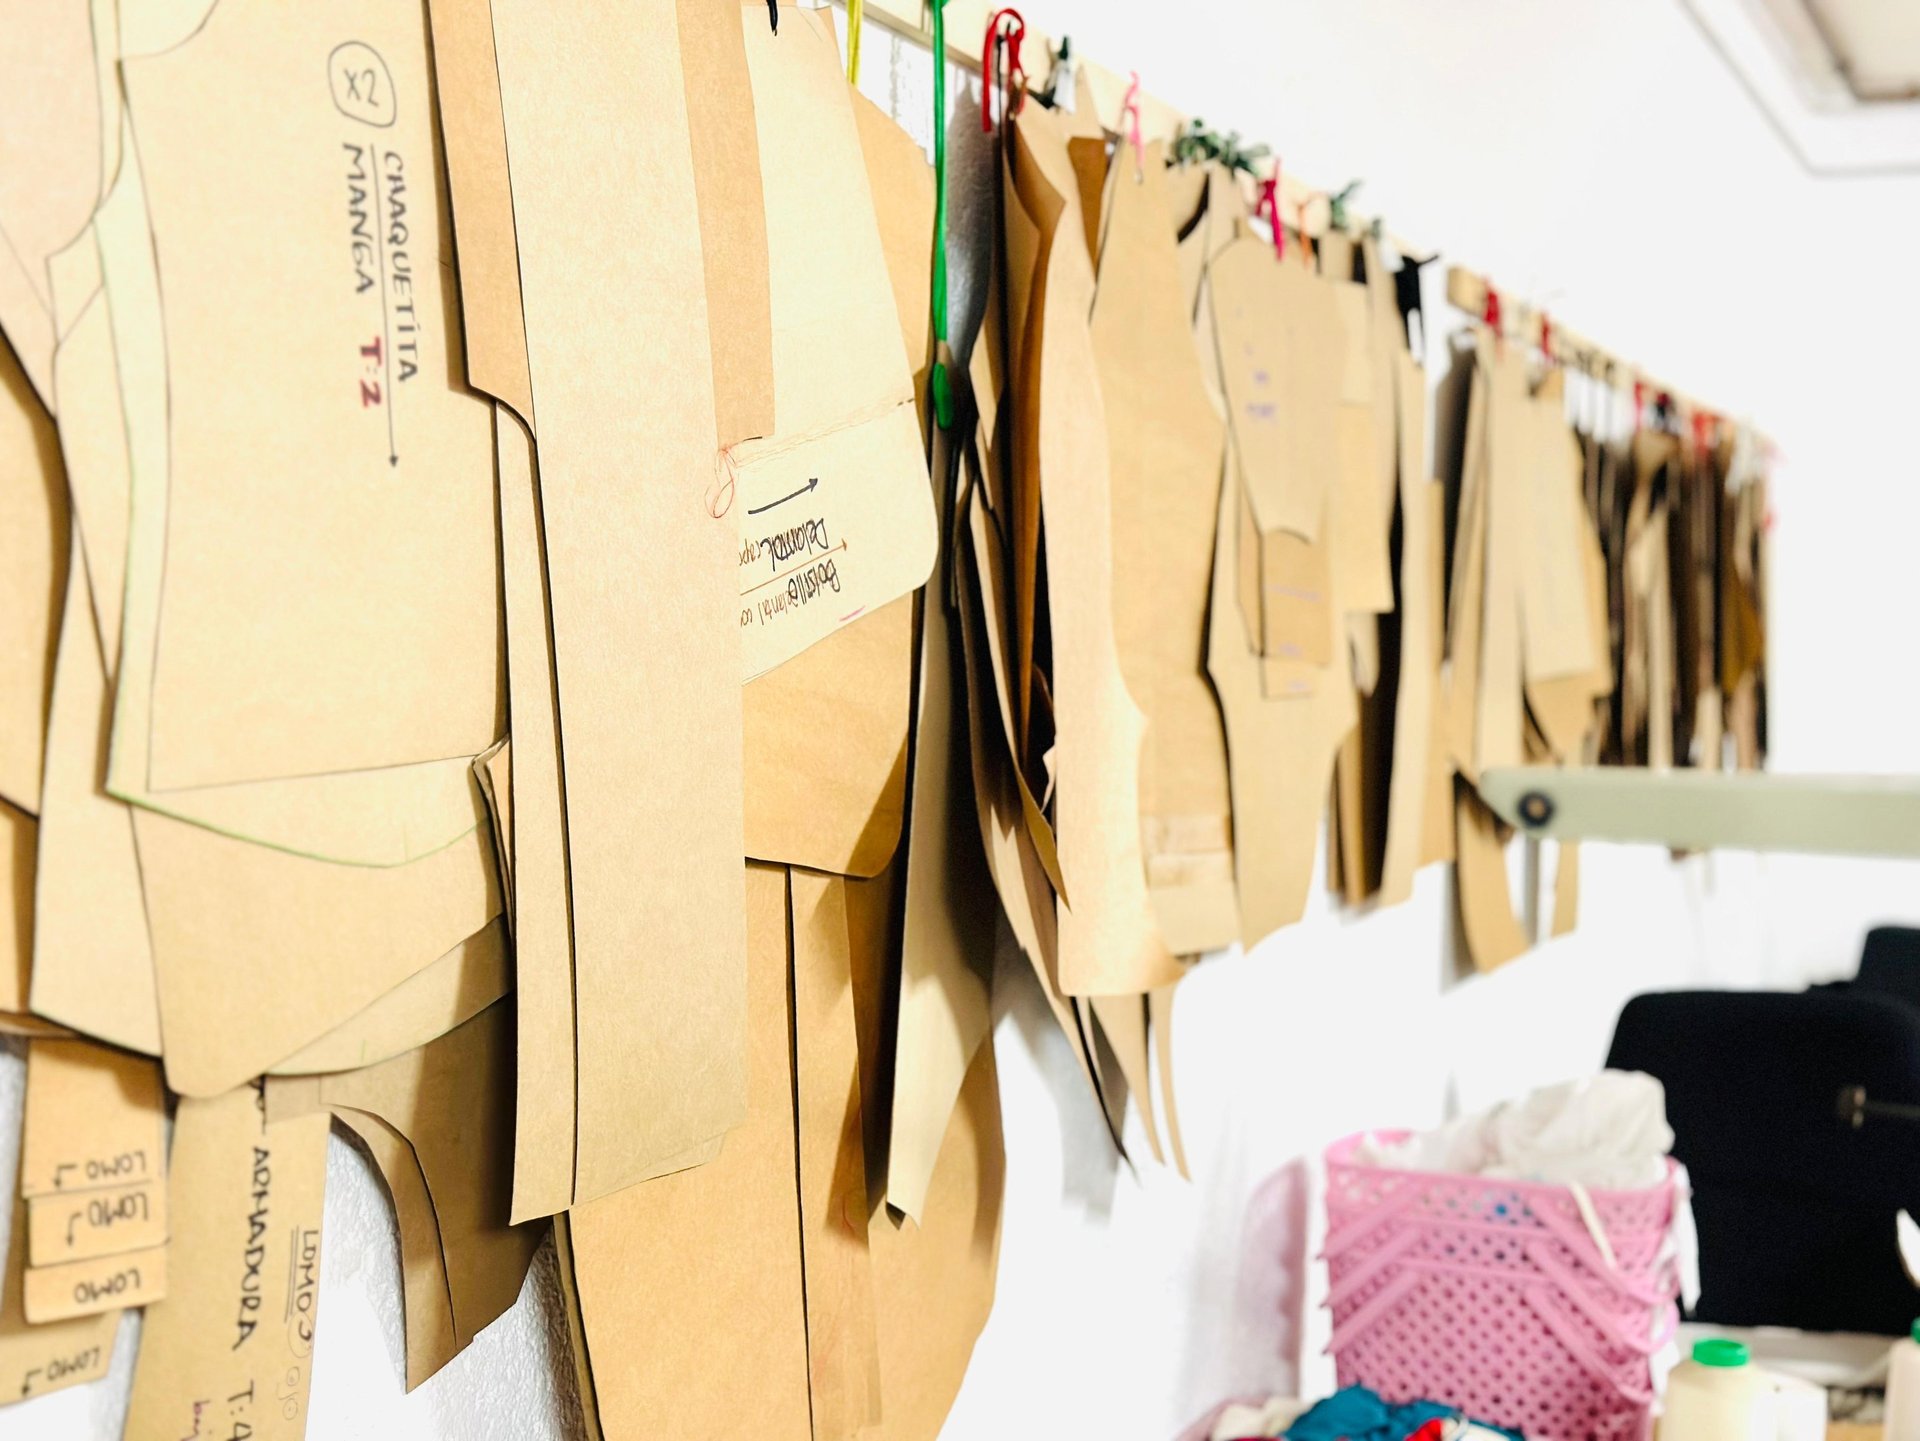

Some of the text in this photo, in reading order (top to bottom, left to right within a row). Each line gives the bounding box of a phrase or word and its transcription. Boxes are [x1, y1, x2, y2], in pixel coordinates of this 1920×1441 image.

[343, 143, 375, 294] MANGA
[86, 1150, 147, 1181] LOMO
[88, 1191, 148, 1227] LOMO
[231, 1146, 271, 1351] ARMADURA
[74, 1268, 140, 1304] LOMO
[296, 1229, 319, 1313] LOMO
[47, 1346, 102, 1382] LOMO
